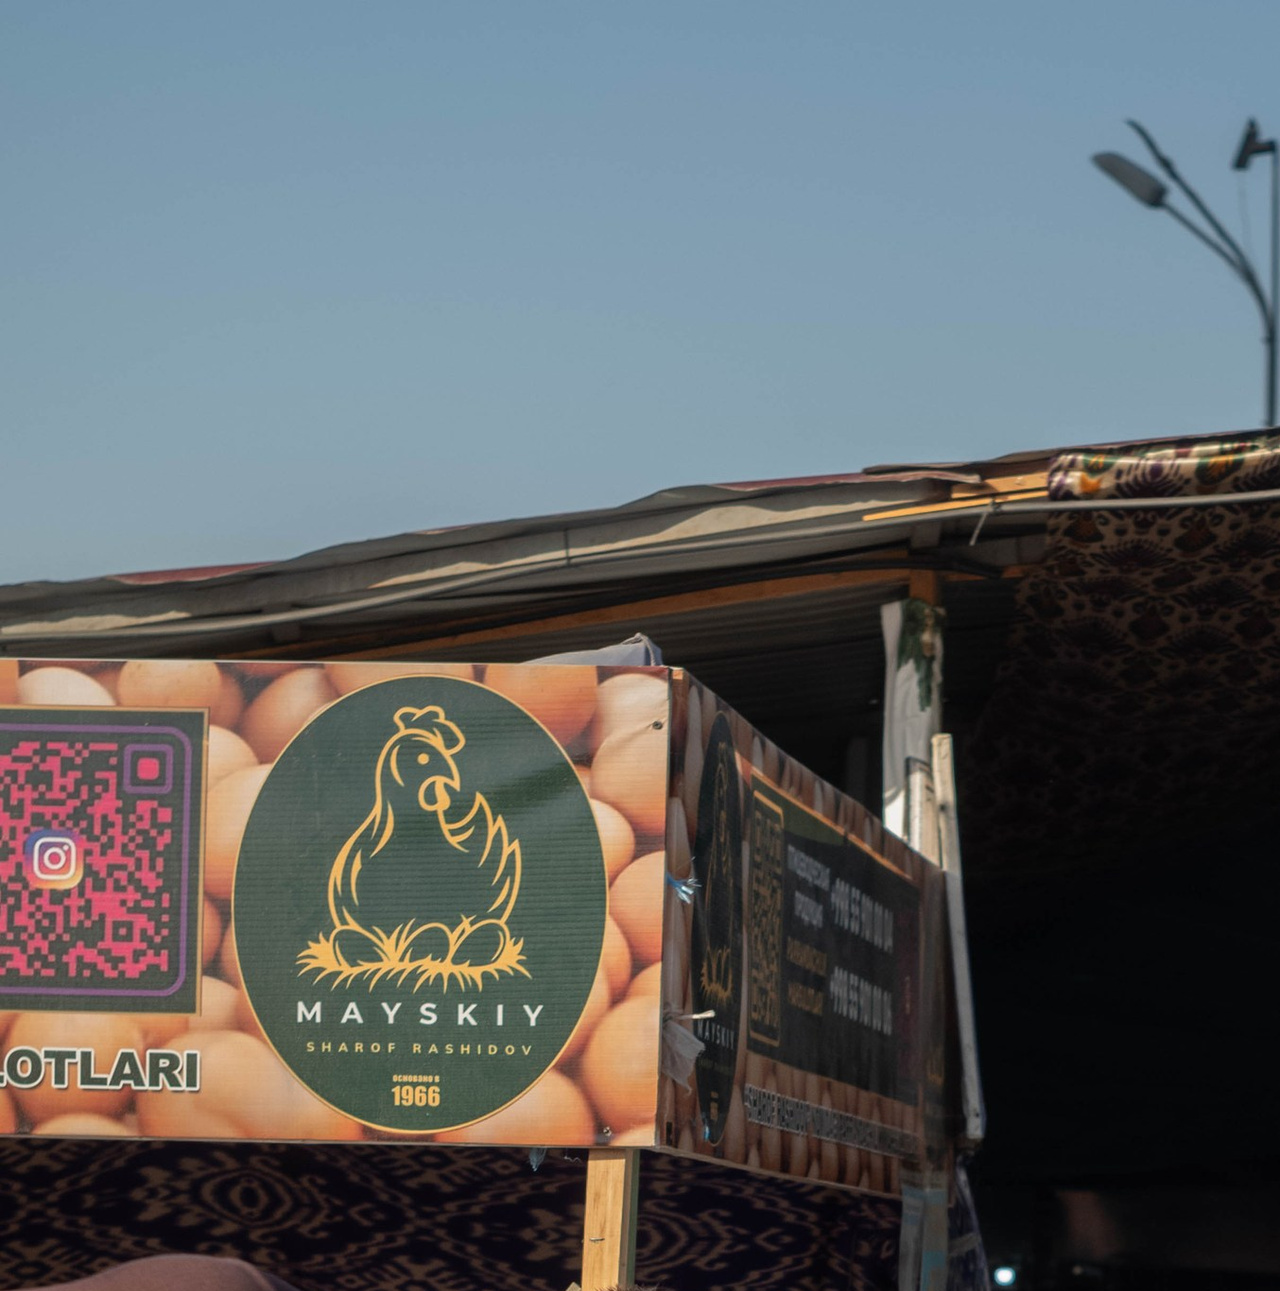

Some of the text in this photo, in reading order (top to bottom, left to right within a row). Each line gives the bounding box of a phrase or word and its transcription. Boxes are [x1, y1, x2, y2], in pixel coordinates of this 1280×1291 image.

[296, 1000, 544, 1027] MAYSKIY
[306, 1041, 532, 1056] SHAROF RASHIDOV
[0, 1046, 200, 1091] OTLARI
[391, 1085, 441, 1107] 1966
